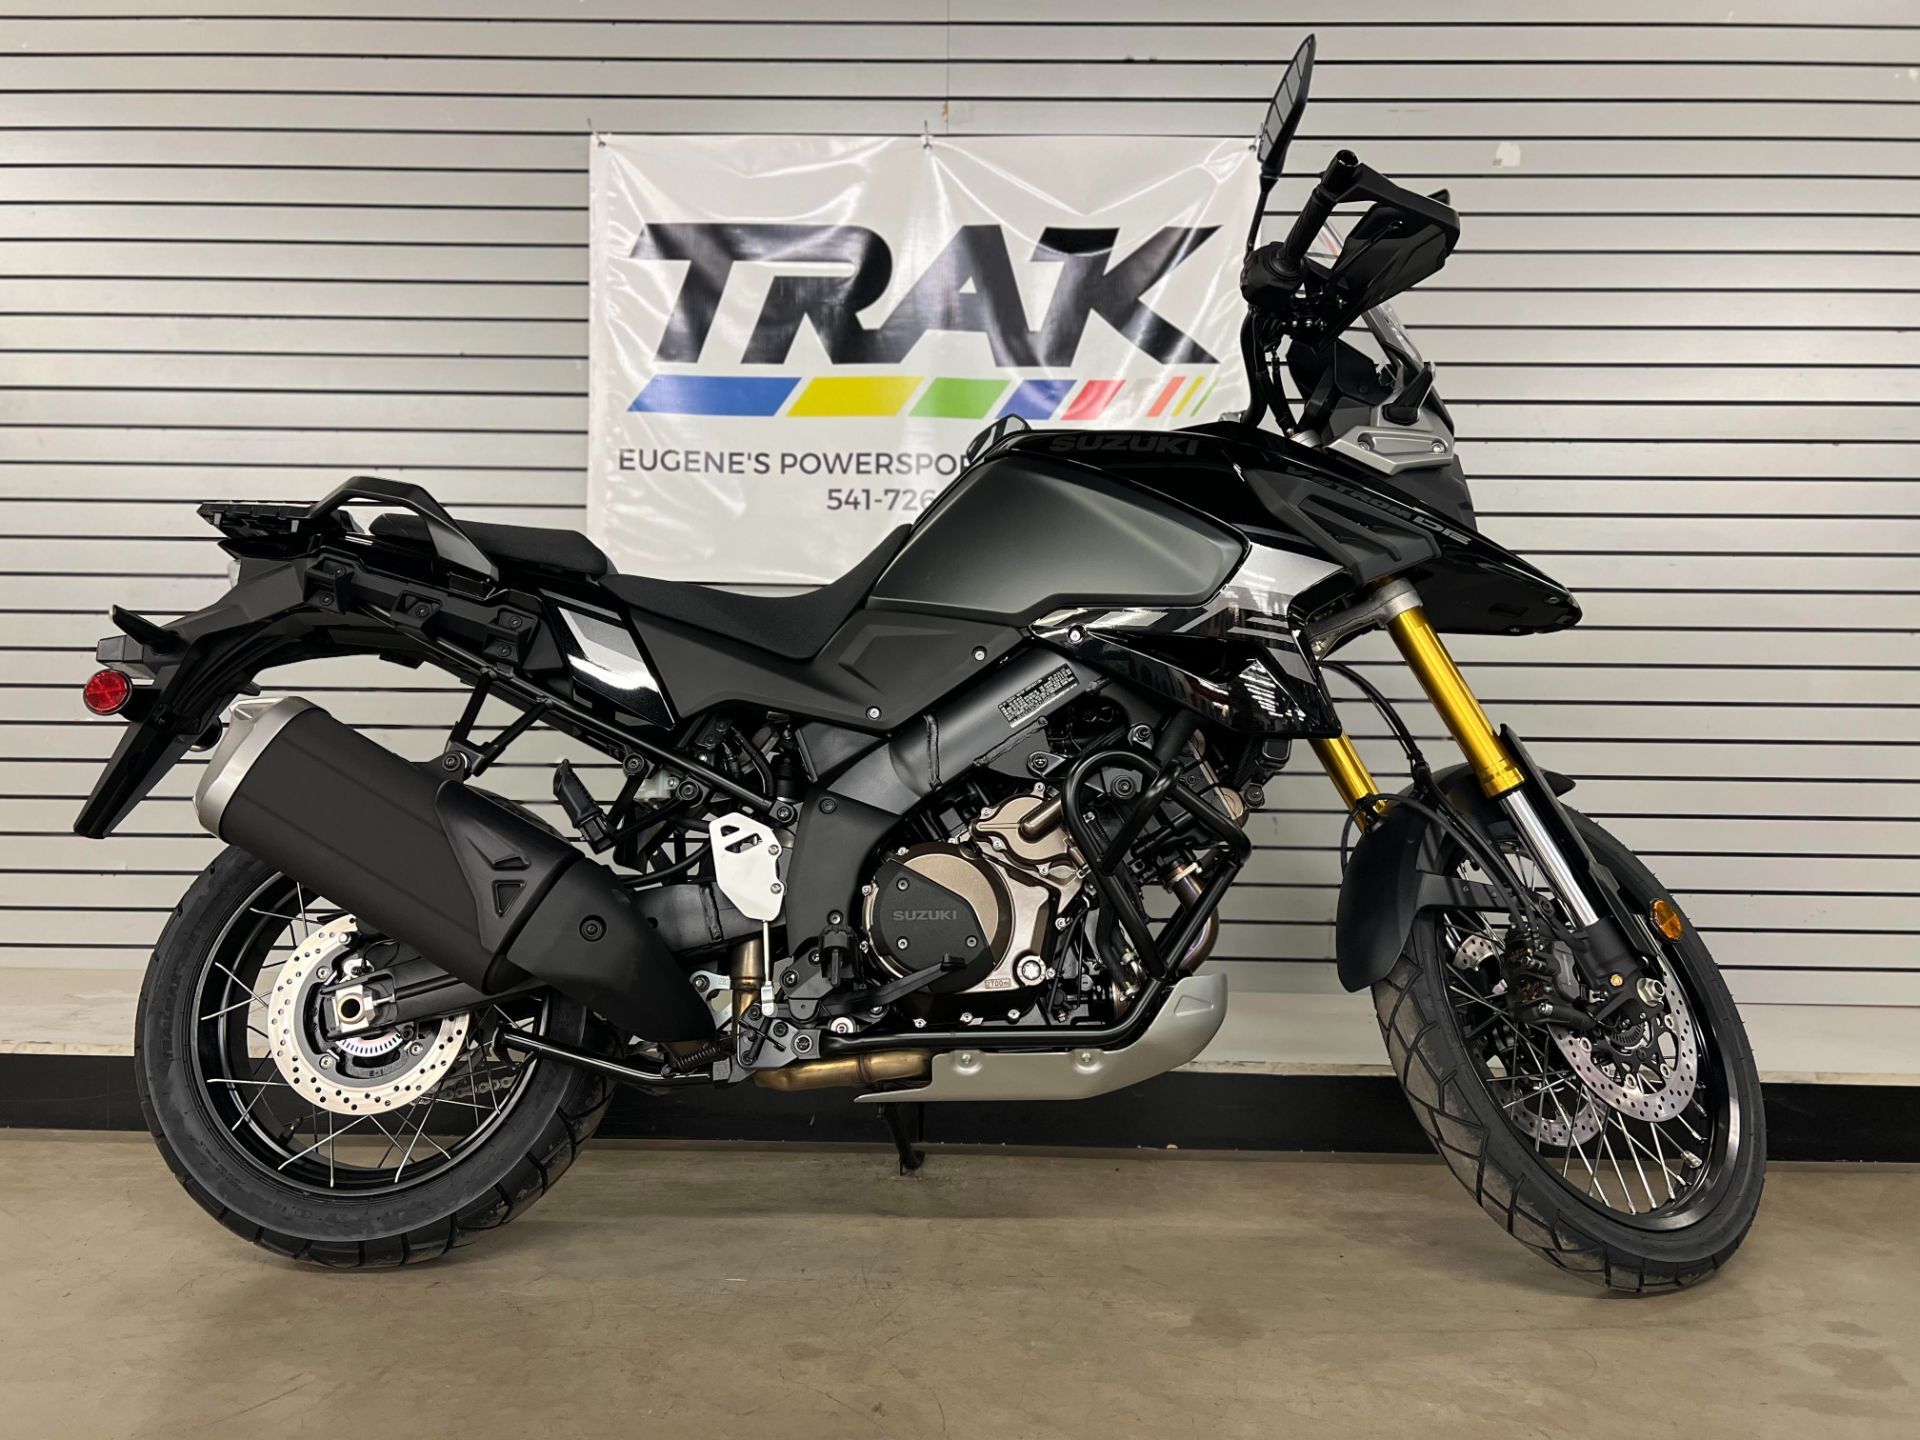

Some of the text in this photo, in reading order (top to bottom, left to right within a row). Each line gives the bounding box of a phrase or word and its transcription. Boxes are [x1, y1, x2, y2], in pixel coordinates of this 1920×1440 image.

[629, 222, 1224, 367] TRAK
[1049, 434, 1201, 456] SUZUKI
[618, 448, 771, 475] EUGENE'S
[1411, 514, 1472, 546] DE
[892, 910, 957, 921] SUZUKI
